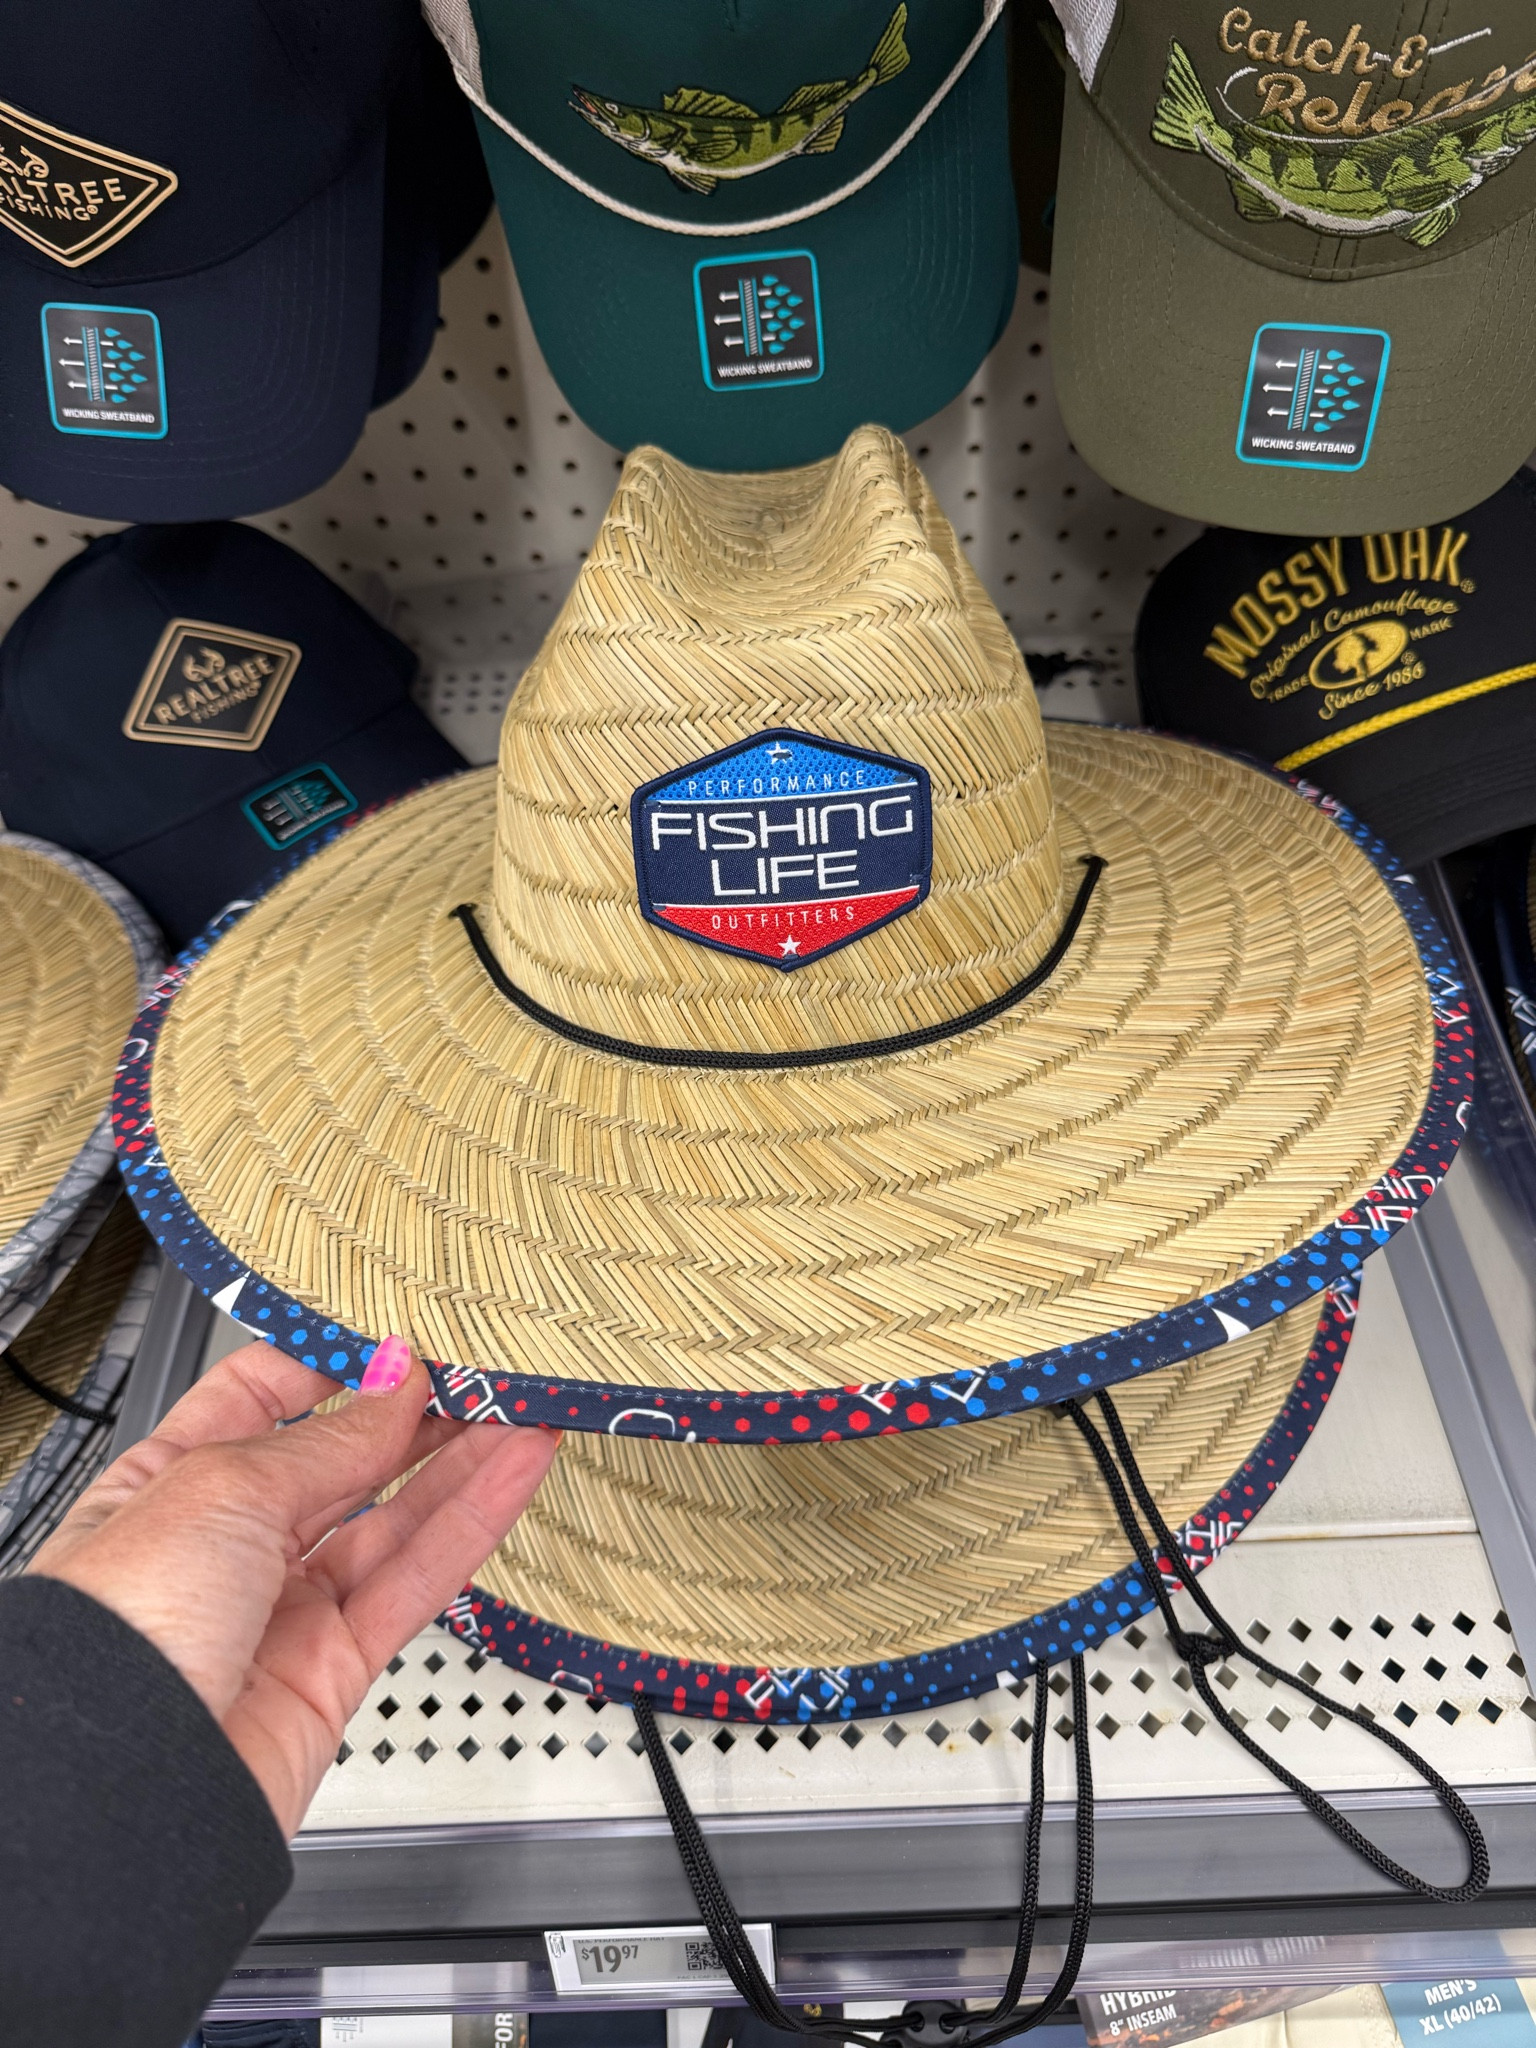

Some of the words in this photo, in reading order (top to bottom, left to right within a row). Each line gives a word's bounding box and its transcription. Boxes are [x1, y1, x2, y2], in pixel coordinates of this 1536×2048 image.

[1219, 6, 1378, 75] Catch
[717, 362, 757, 378] WICKING
[757, 356, 813, 374] SWEATBAND
[62, 408, 100, 420] WICKING
[100, 410, 155, 423] SWEATBAND
[1251, 437, 1294, 450] WICKING
[1295, 441, 1355, 454] SWEATBAND
[1203, 536, 1350, 680] MOSSY
[1250, 617, 1322, 700] Original
[1323, 587, 1460, 633] Camouflage
[1409, 615, 1454, 641] MARK
[153, 653, 274, 725] REALTREE
[1318, 681, 1382, 720] Since
[688, 769, 866, 796] PERFORMANCE
[651, 795, 914, 851] FISHING
[710, 849, 860, 897] LIFE
[711, 906, 855, 930] OUTFITTERS
[1424, 1979, 1477, 2006] MEN'S
[1126, 2003, 1177, 2032] INSEAM
[1419, 2014, 1445, 2036] XL
[1444, 1993, 1502, 2030] (40/42)
